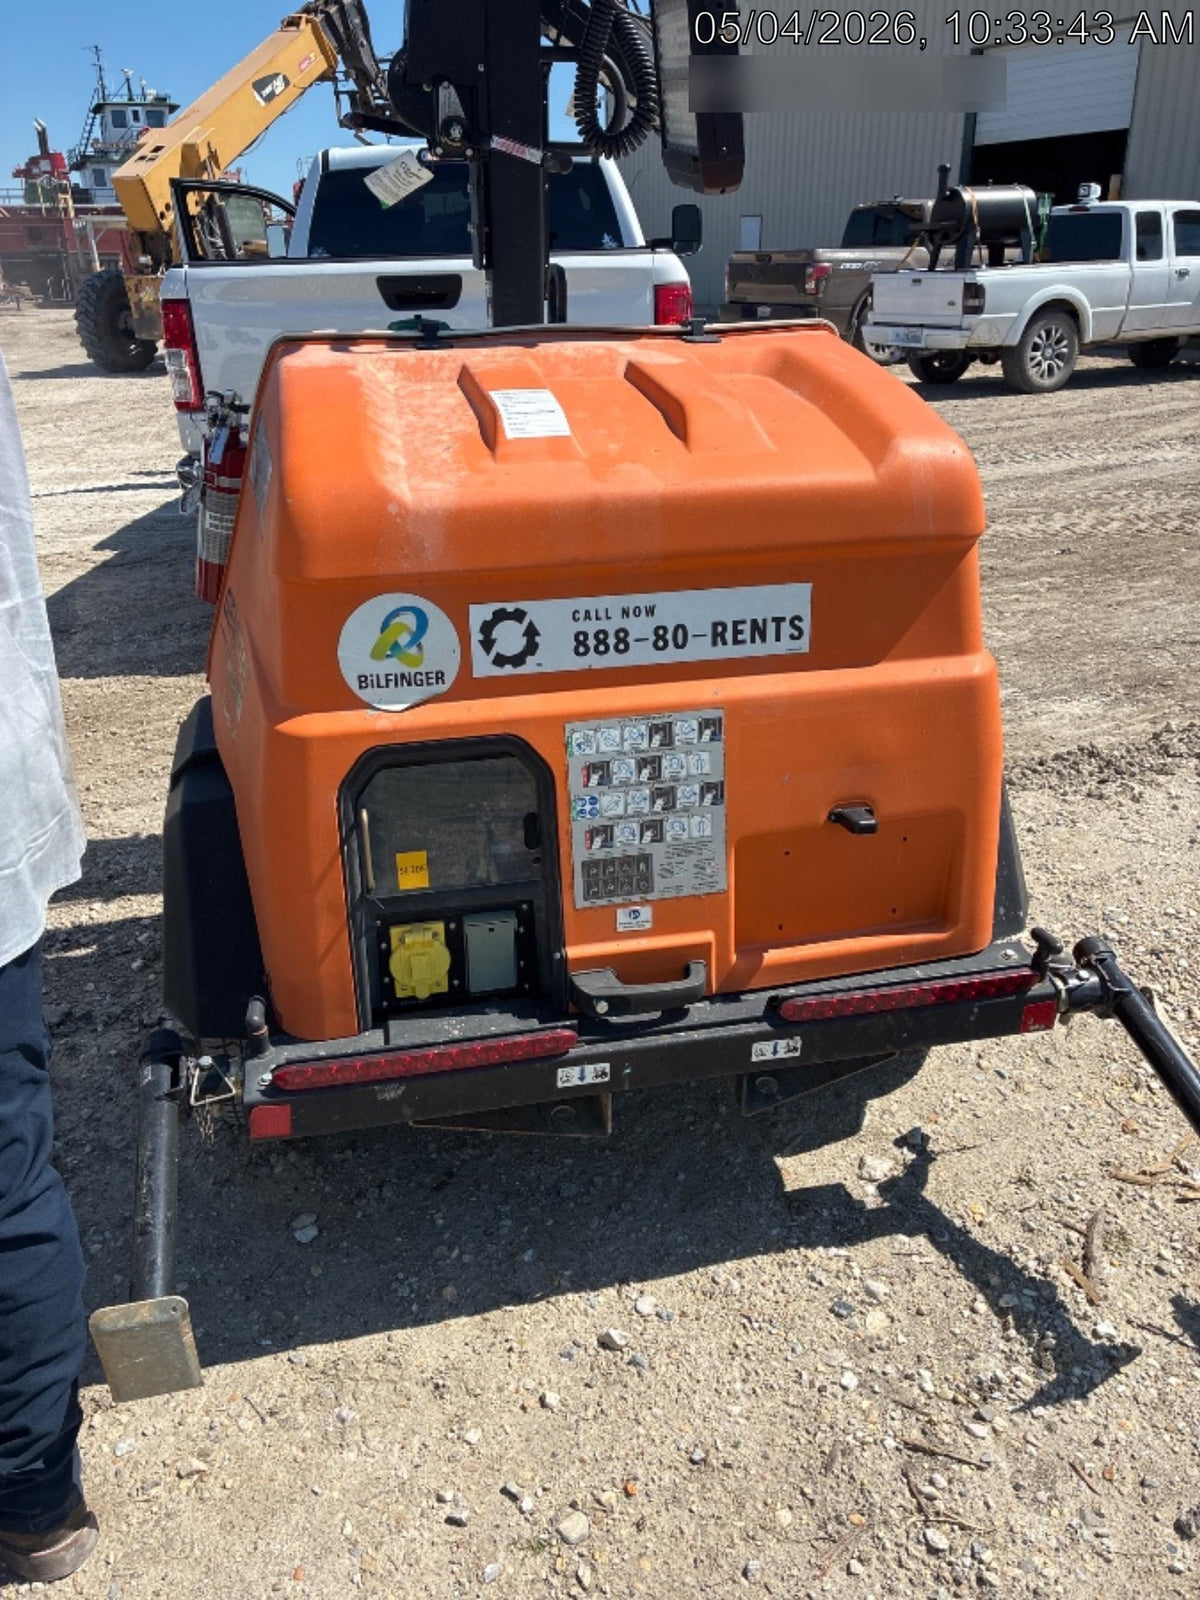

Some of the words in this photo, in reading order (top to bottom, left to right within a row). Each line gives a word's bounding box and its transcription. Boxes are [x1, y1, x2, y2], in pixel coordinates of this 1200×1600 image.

[571, 608, 612, 622] CALL
[621, 604, 657, 619] NOW
[573, 614, 804, 657] 888-80-RENTS
[357, 669, 446, 690] BiLFINGER
